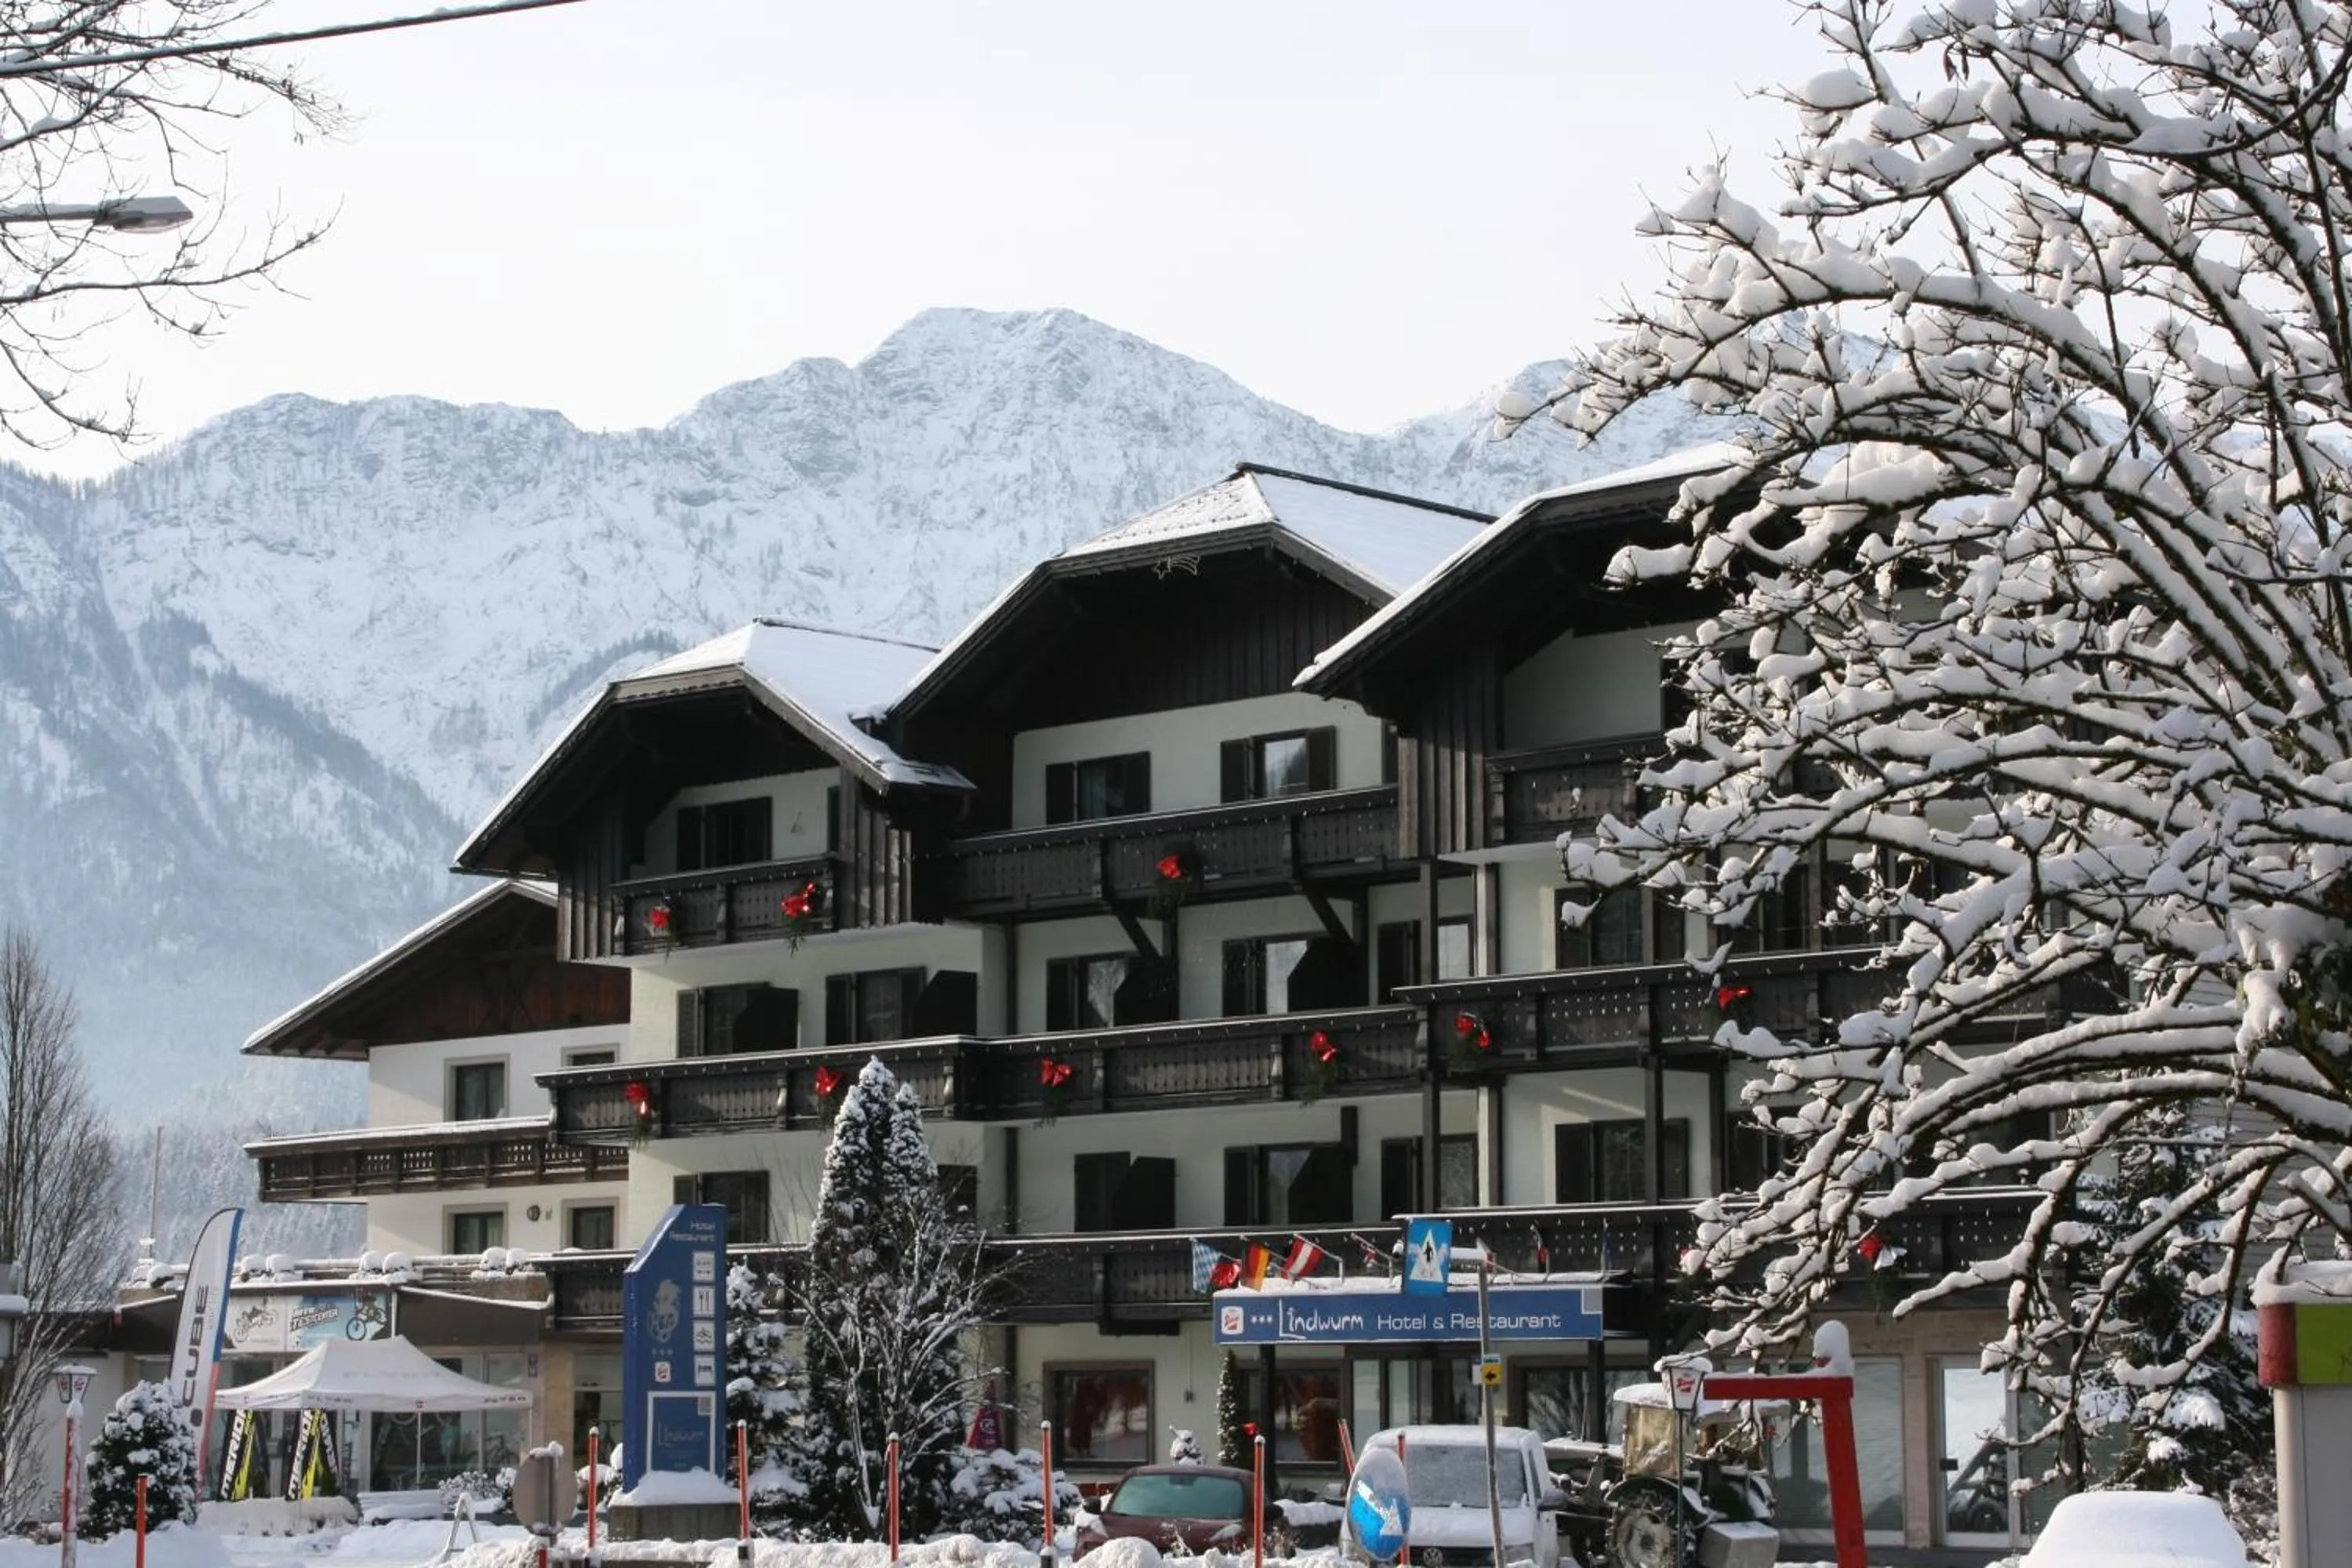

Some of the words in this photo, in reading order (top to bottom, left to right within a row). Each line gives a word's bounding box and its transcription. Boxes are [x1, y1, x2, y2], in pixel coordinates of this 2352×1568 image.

[182, 1285, 209, 1406] CUBE
[1279, 1298, 1363, 1340] Lindwurm
[1377, 1314, 1426, 1330] Hotel
[1433, 1316, 1444, 1329] &
